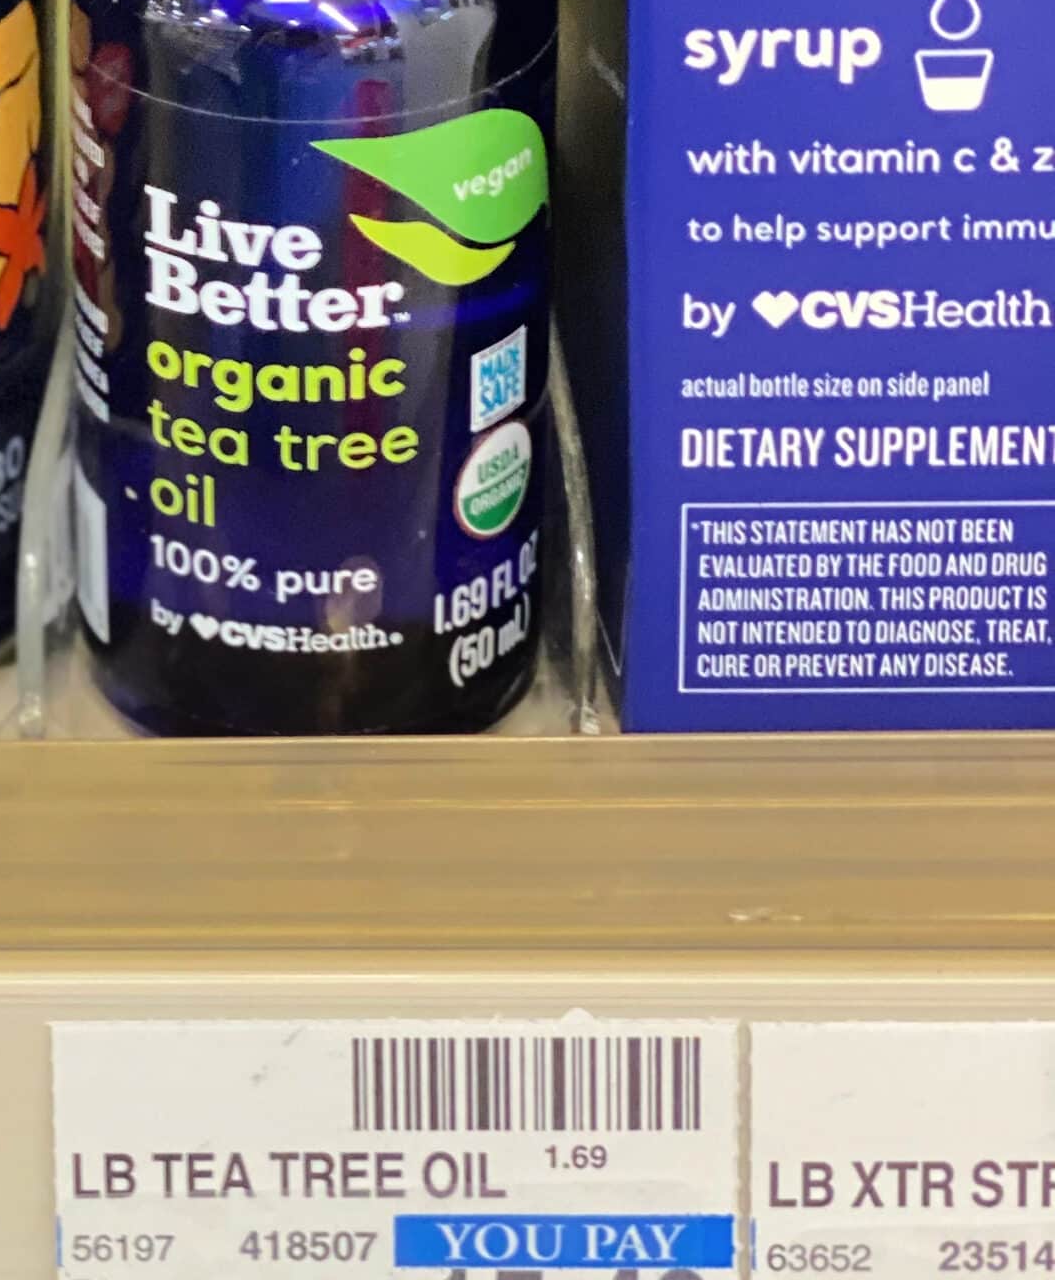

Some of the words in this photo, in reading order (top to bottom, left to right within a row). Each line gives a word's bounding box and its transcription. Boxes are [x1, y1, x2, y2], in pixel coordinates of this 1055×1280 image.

[684, 27, 882, 85] syrup
[452, 147, 532, 201] vegan
[687, 139, 775, 175] with
[788, 139, 940, 175] vitamin
[953, 148, 976, 173] c
[989, 136, 1020, 172] &
[144, 184, 323, 270] Live
[688, 218, 722, 242] to
[733, 213, 806, 249] help
[817, 216, 951, 248] support
[682, 292, 736, 337] by
[800, 290, 1052, 329] CVSHealth
[146, 340, 407, 413] organic
[480, 344, 521, 383] MADE
[480, 373, 522, 417] SAFE
[681, 372, 745, 398] actual
[749, 372, 808, 397] bottle
[813, 373, 852, 397] size
[858, 379, 882, 397] on
[887, 371, 929, 396] side
[933, 370, 989, 401] panel
[147, 399, 249, 466] tea
[273, 425, 419, 471] tree
[681, 427, 825, 467] DIETARY
[477, 442, 520, 485] USDA
[150, 473, 215, 528] oil
[751, 519, 867, 544] STATEMENT
[871, 519, 912, 543] HAS
[916, 519, 957, 543] NOT
[961, 519, 1014, 543] BEEN
[150, 534, 261, 592] 100%
[276, 568, 377, 604] pure
[699, 554, 812, 578] EVALUATED
[816, 554, 841, 577] BY
[847, 553, 883, 577] THE
[889, 553, 941, 577] FOOD
[945, 553, 987, 577] AND
[992, 552, 1047, 576] DRUG
[151, 598, 184, 635] by
[434, 577, 487, 634] 1.69
[492, 560, 517, 608] FL
[698, 587, 874, 611] ADMINISTRATION.
[879, 586, 924, 610] THIS
[929, 586, 1023, 610] PRODUCT
[1027, 586, 1047, 609] IS
[698, 621, 739, 645] NOT
[742, 620, 841, 645] INTENDED
[845, 620, 870, 644] TO
[875, 620, 981, 645] DIAGNOSE,
[986, 619, 1053, 645] TREAT,
[450, 626, 494, 688] (50
[697, 654, 750, 678] CURE
[753, 654, 781, 678] OR
[785, 654, 877, 677] PREVENT
[879, 653, 920, 677] ANY
[925, 653, 1014, 677] DISEASE.
[72, 1152, 136, 1199] LB
[152, 1152, 255, 1199] TEA
[270, 1152, 405, 1198] TREE
[422, 1151, 506, 1199] OIL
[545, 1145, 607, 1169] 1.69
[769, 1161, 834, 1208] LB
[852, 1161, 955, 1208] XTR
[72, 1235, 175, 1262] 56197
[239, 1230, 377, 1261] 418507
[436, 1222, 564, 1262] YOU
[582, 1222, 686, 1261] PAY
[767, 1244, 872, 1271] 63652
